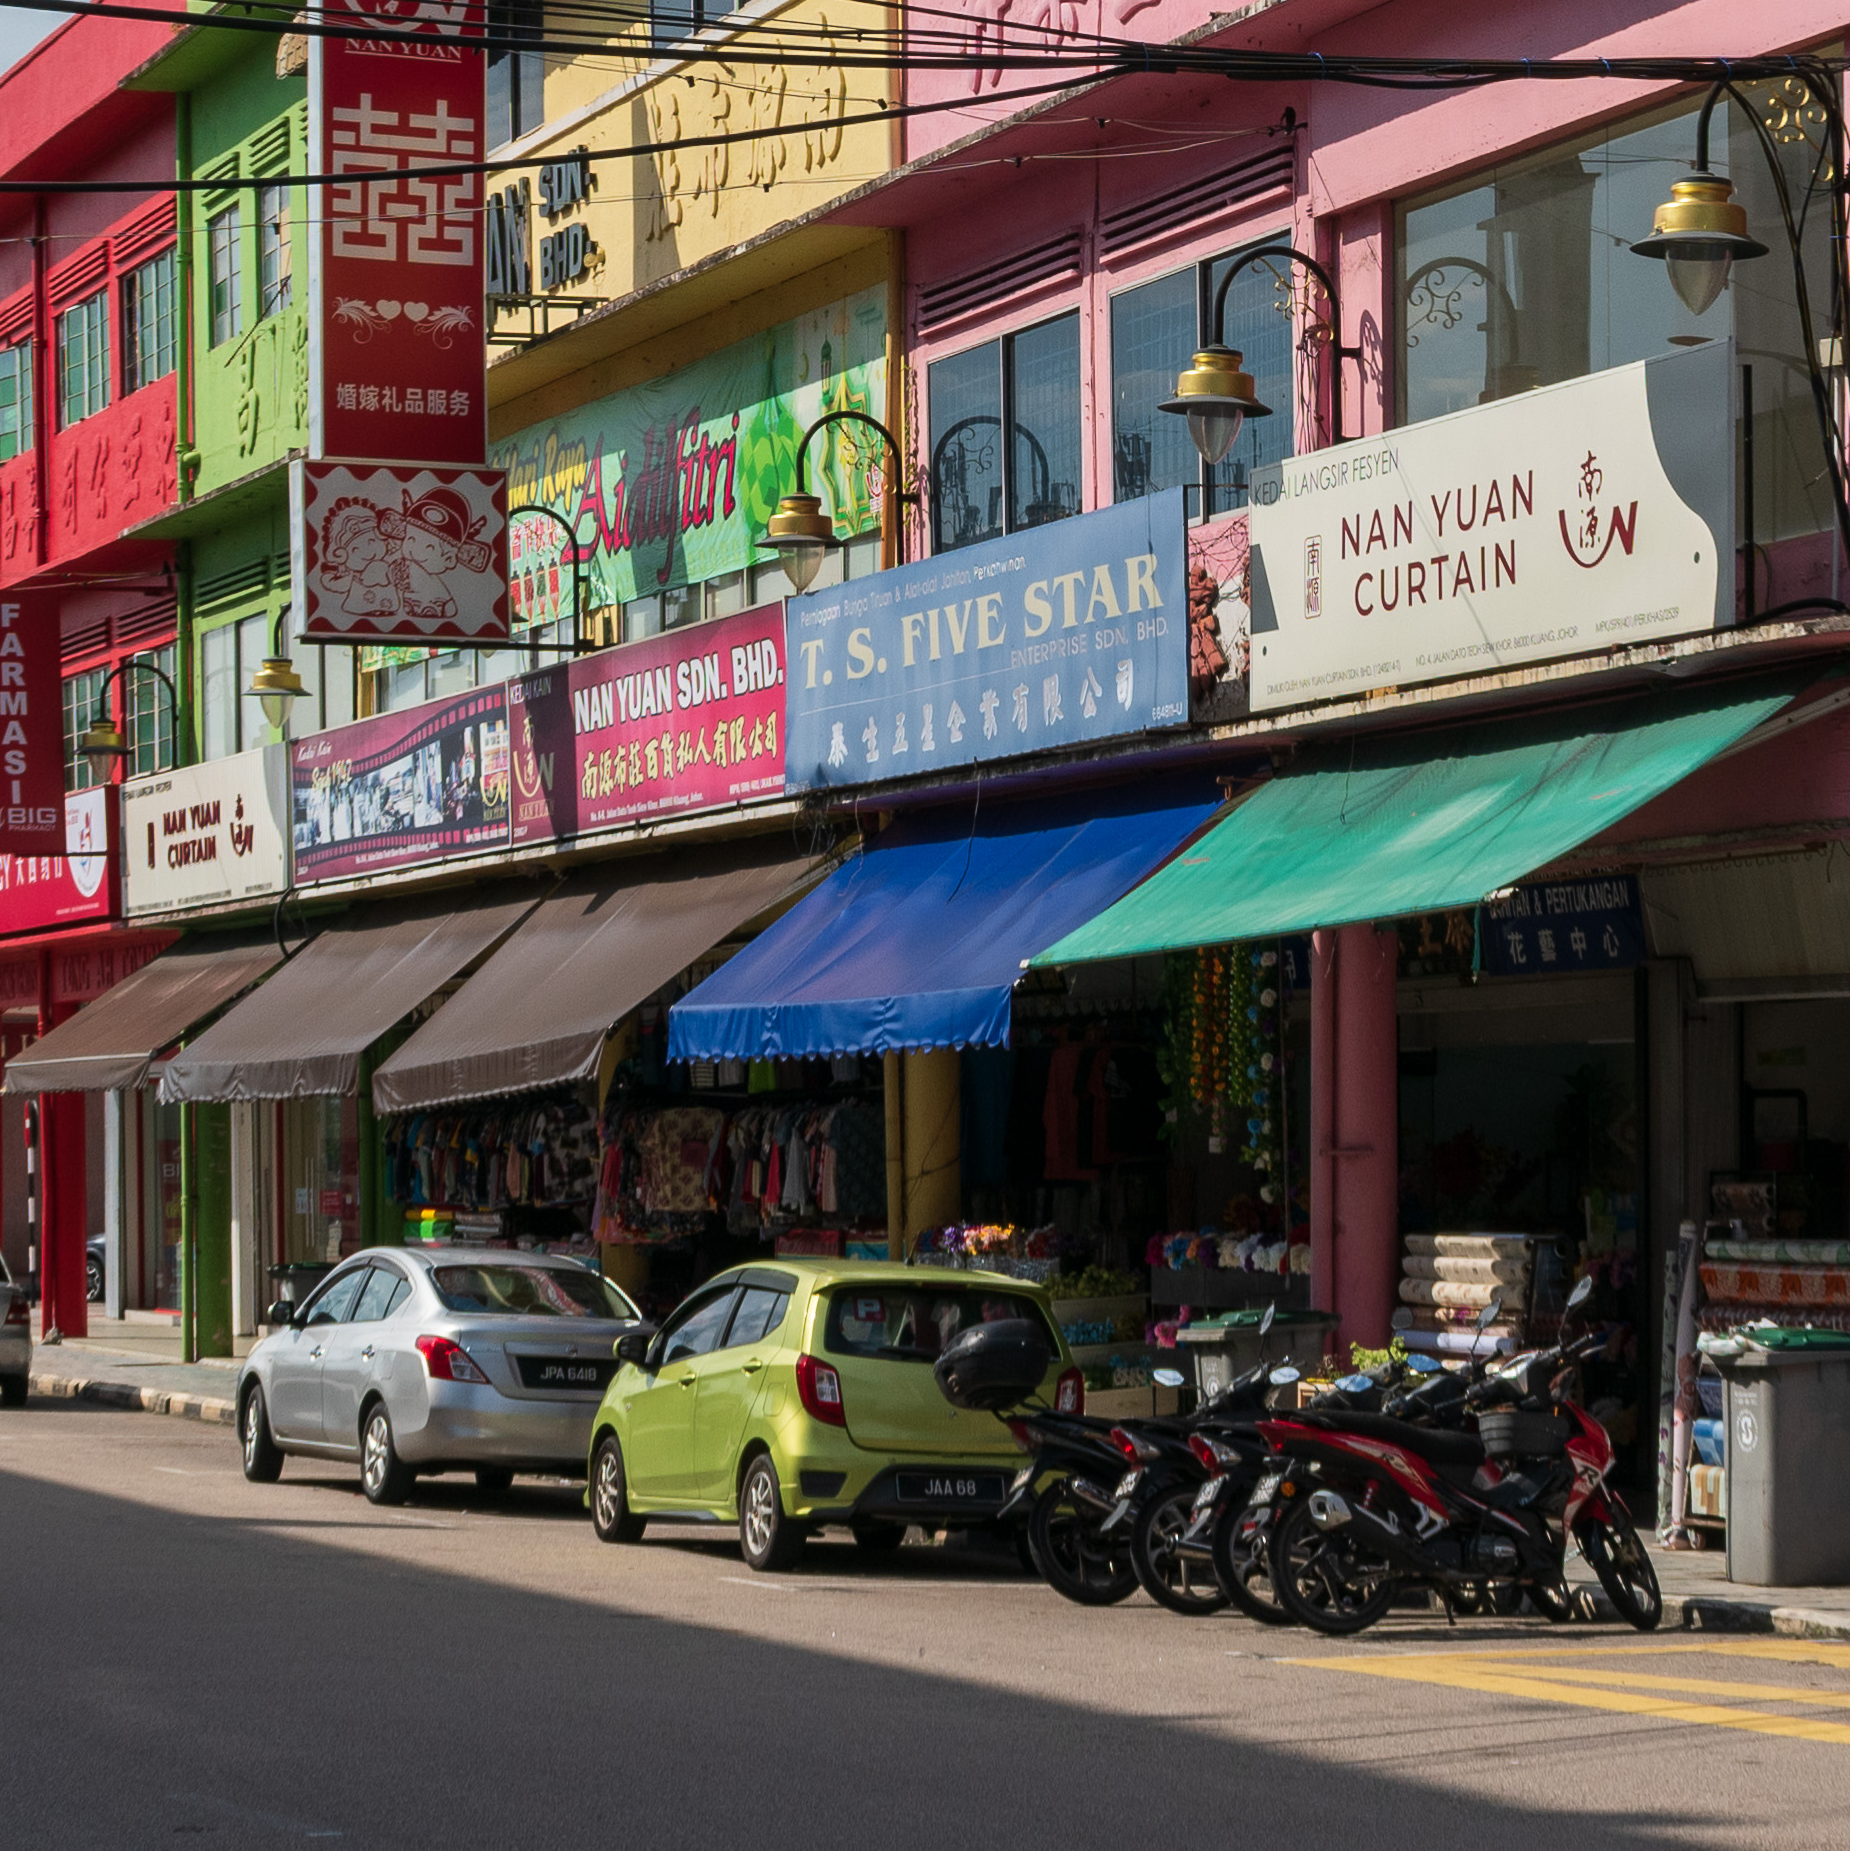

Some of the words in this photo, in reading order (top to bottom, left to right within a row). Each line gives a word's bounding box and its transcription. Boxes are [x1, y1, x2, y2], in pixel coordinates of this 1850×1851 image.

[401, 41, 462, 59] YUAN
[336, 382, 471, 417] 婚嫁礼品服务
[1254, 476, 1292, 507] KEDAI
[1294, 461, 1349, 499] LANGSIR
[1352, 447, 1399, 483] FESYEN
[1341, 500, 1413, 560] NAN
[1431, 469, 1533, 538] YUAN
[895, 585, 901, 602] &
[1354, 539, 1517, 617] CURTAIN
[799, 638, 833, 689] T.
[846, 627, 887, 680] S.
[901, 591, 1007, 668] FIVE
[1024, 553, 1165, 638] STAR
[1010, 633, 1088, 669] ENTERPRISE
[1137, 616, 1170, 642] BHD.
[0, 603, 28, 805] FARMASI
[510, 680, 532, 705] KEDAI
[573, 679, 615, 736] NAN
[616, 664, 674, 724] YUAN
[676, 652, 728, 710] SDN.
[730, 637, 784, 697] BHD.
[827, 657, 1134, 768] 泰生五星企業有限公司
[7, 807, 58, 824] BIG
[163, 807, 187, 836] NAN
[190, 799, 221, 830] YUAN
[167, 835, 217, 870] CURTAIN
[1534, 890, 1543, 915] &
[1545, 880, 1631, 915] PERTUKANGAN
[1507, 923, 1620, 965] 花藝中心
[540, 1366, 565, 1380] JPA
[924, 1478, 954, 1496] JAA
[956, 1479, 977, 1496] 68
